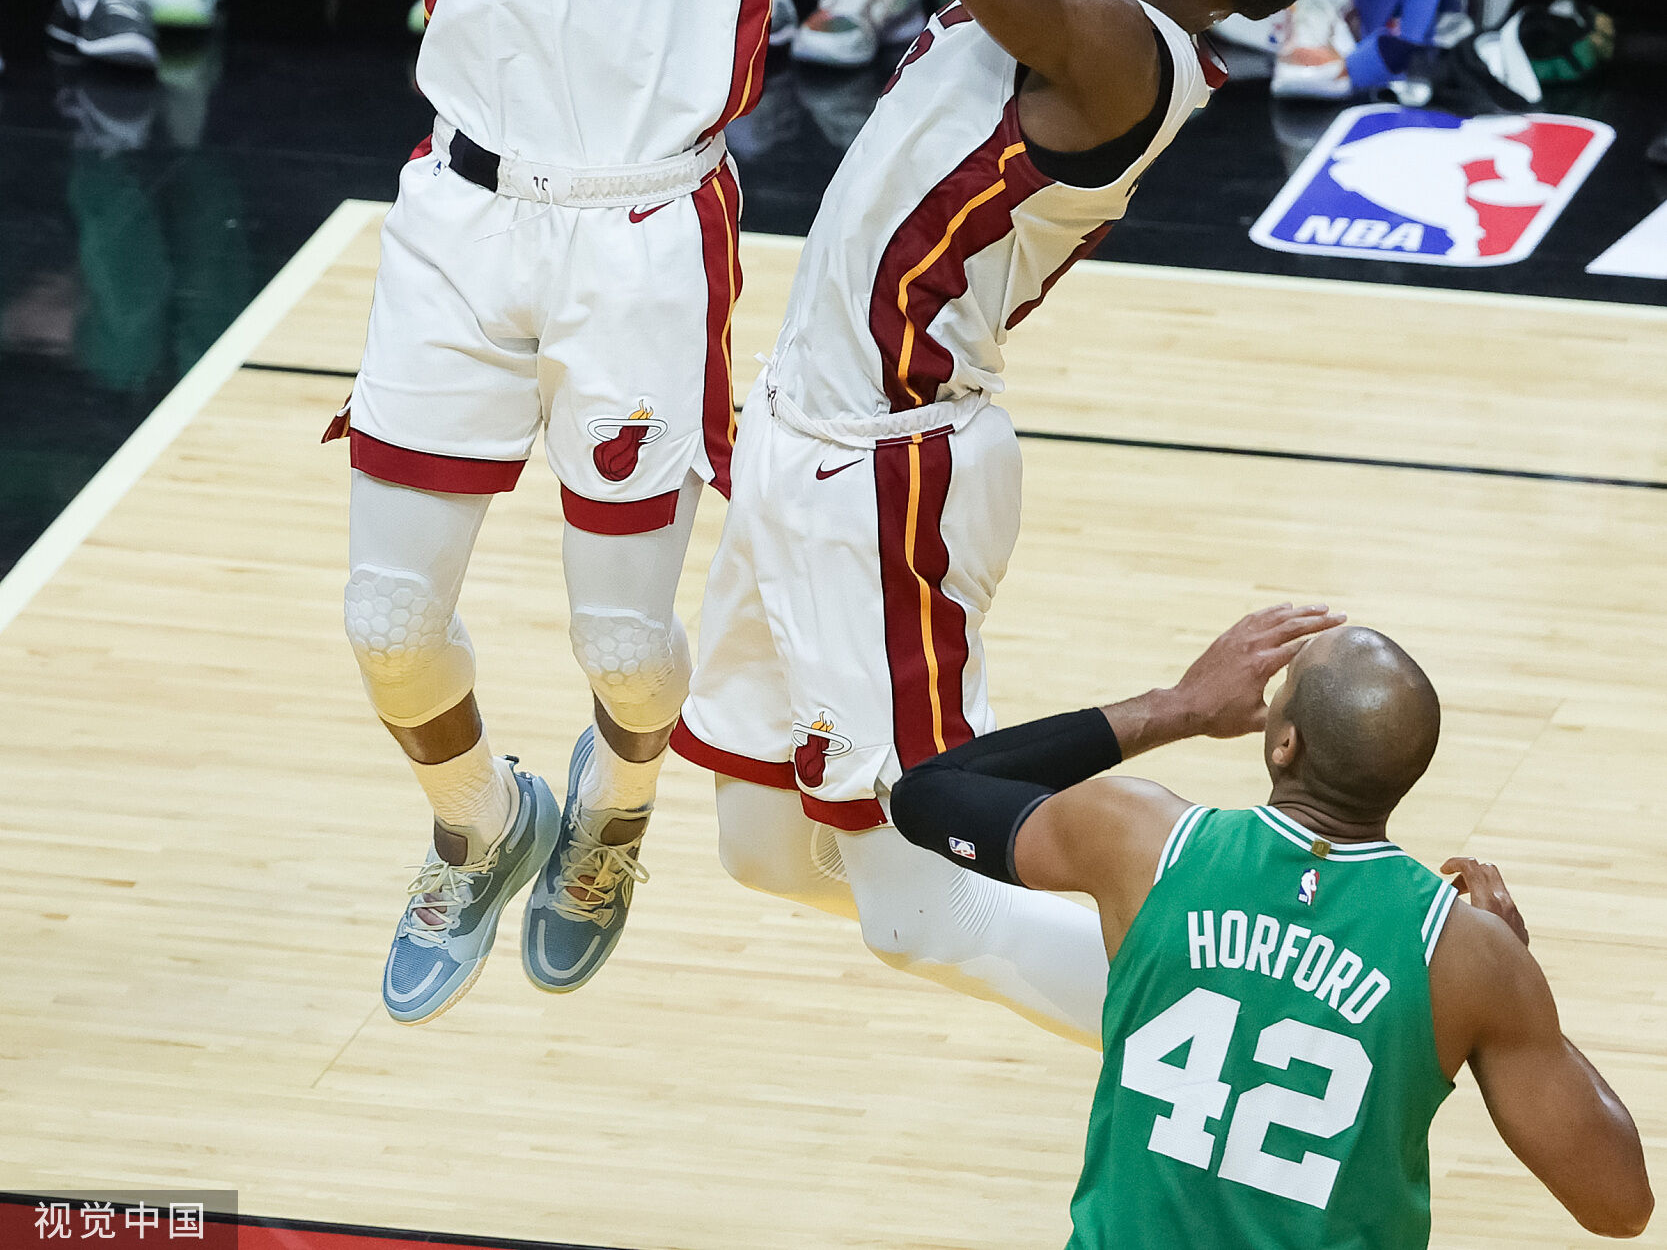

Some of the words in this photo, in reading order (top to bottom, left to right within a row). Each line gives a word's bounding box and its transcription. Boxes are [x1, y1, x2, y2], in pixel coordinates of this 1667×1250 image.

[1294, 214, 1425, 251] NBA
[1187, 909, 1391, 1024] HORFORD
[1120, 987, 1374, 1210] 42
